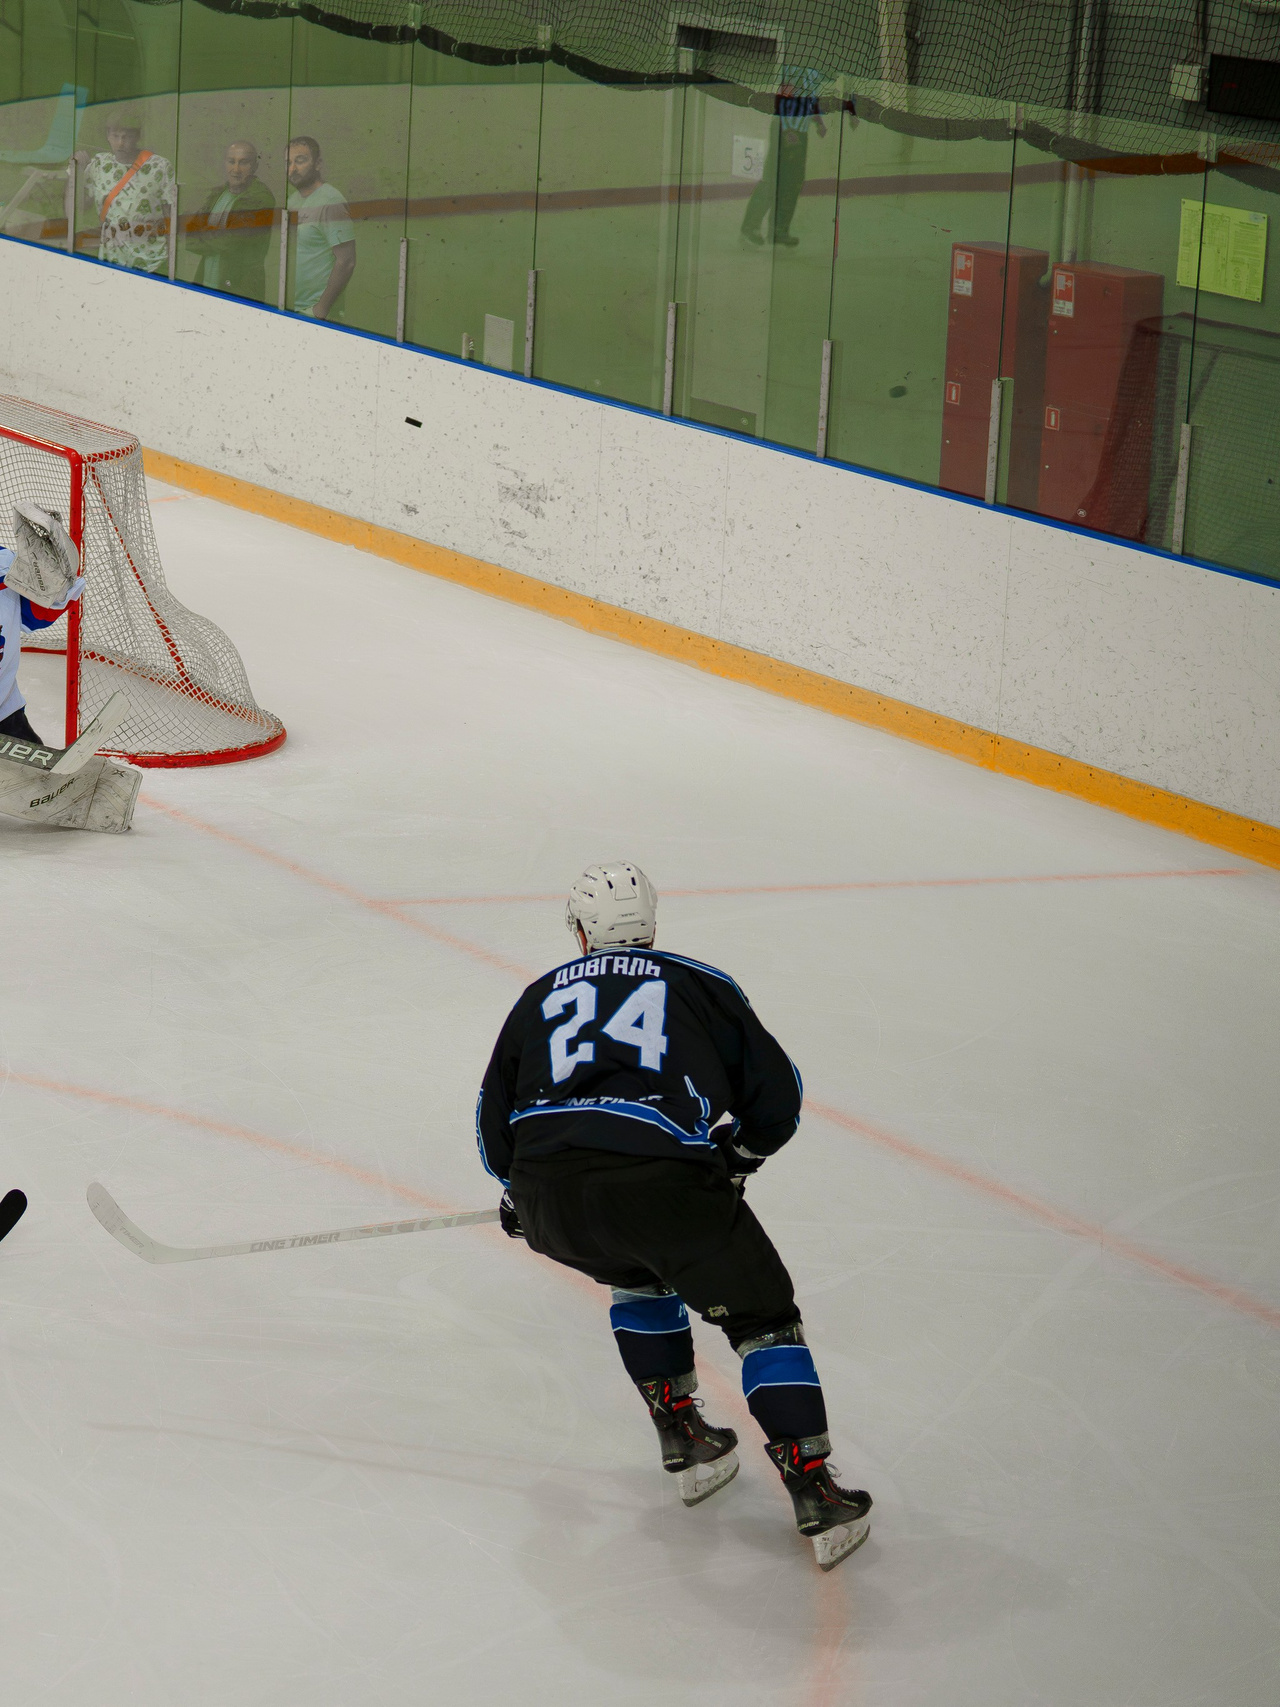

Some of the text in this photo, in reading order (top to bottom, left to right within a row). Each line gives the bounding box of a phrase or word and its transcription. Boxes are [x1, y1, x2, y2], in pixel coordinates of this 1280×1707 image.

[742, 146, 753, 172] 5
[29, 777, 76, 808] BAUER
[552, 955, 661, 990] ДОВГАЛЬ
[540, 979, 669, 1086] 24
[289, 1232, 341, 1249] TIMER
